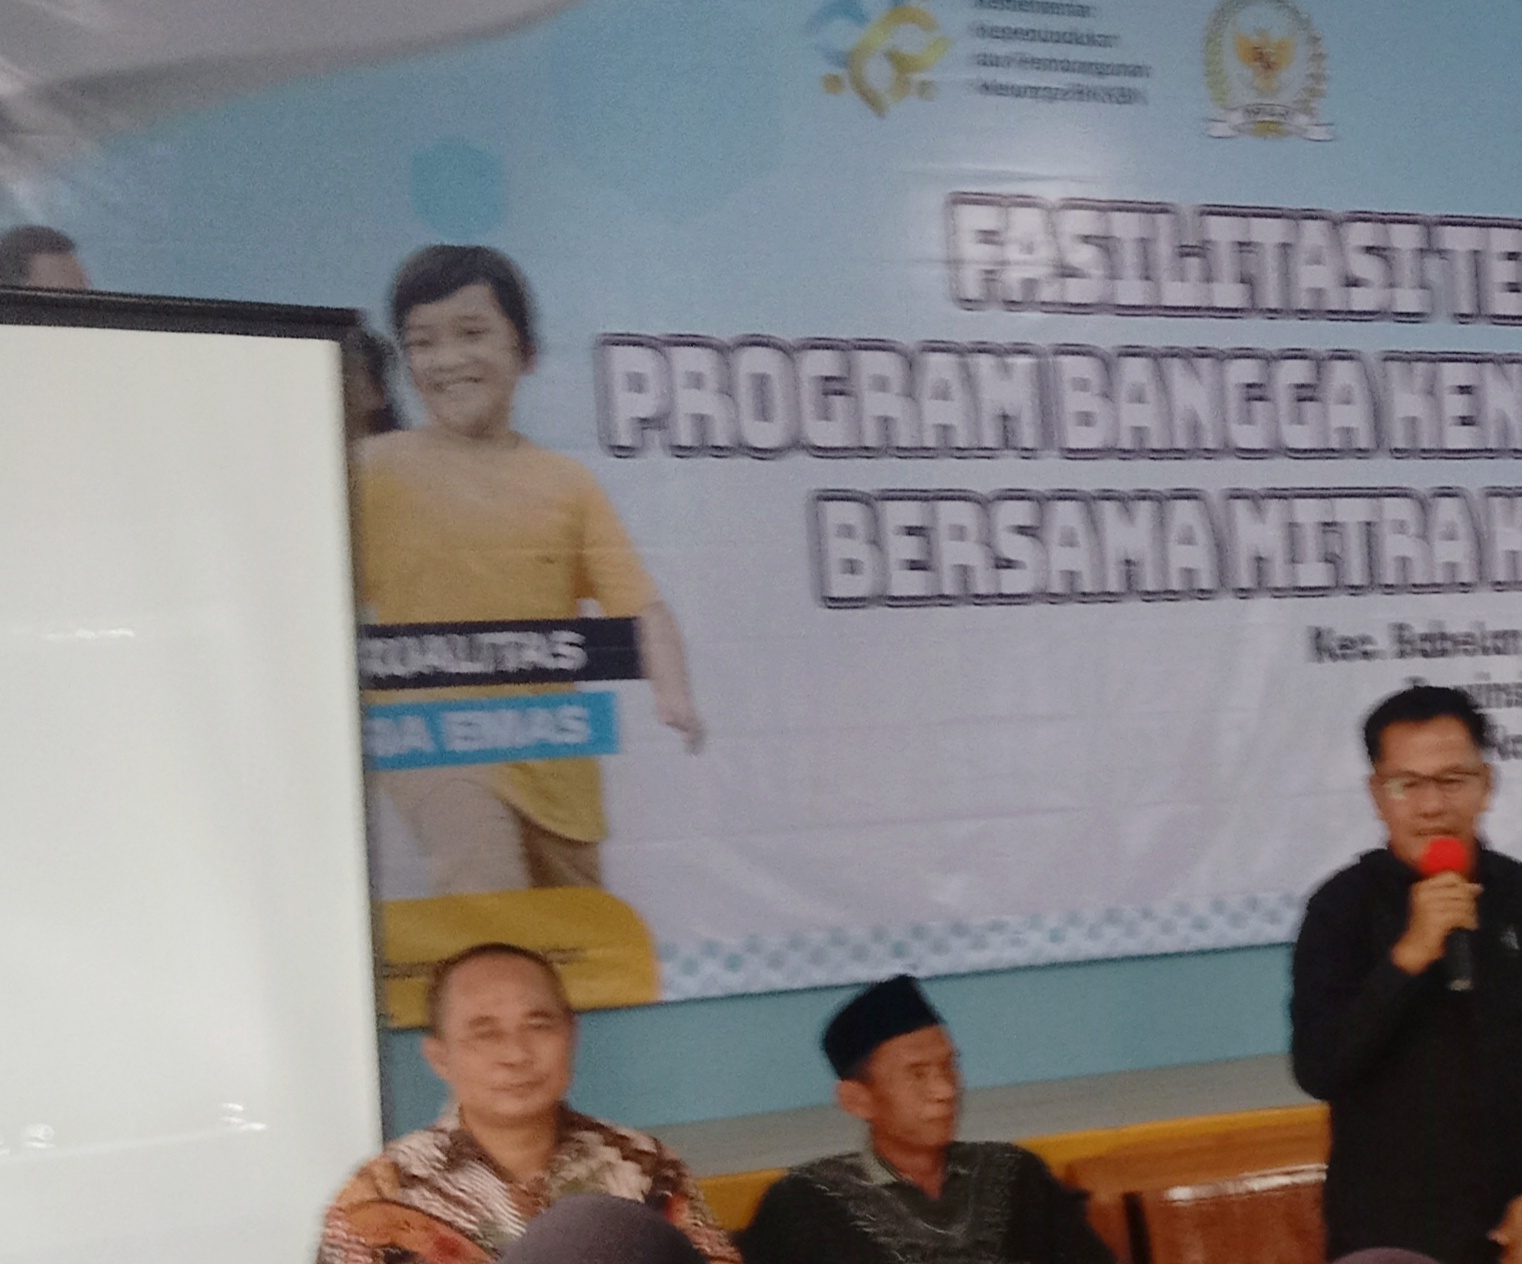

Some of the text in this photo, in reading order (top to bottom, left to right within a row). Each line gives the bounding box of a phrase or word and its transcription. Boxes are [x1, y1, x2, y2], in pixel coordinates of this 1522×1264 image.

[944, 191, 1431, 324] FASILITASI
[594, 333, 1043, 460] PROGRAM
[1046, 343, 1378, 460] BANGGA
[806, 487, 1221, 609] BERSAMA
[1218, 486, 1484, 600] MITRA
